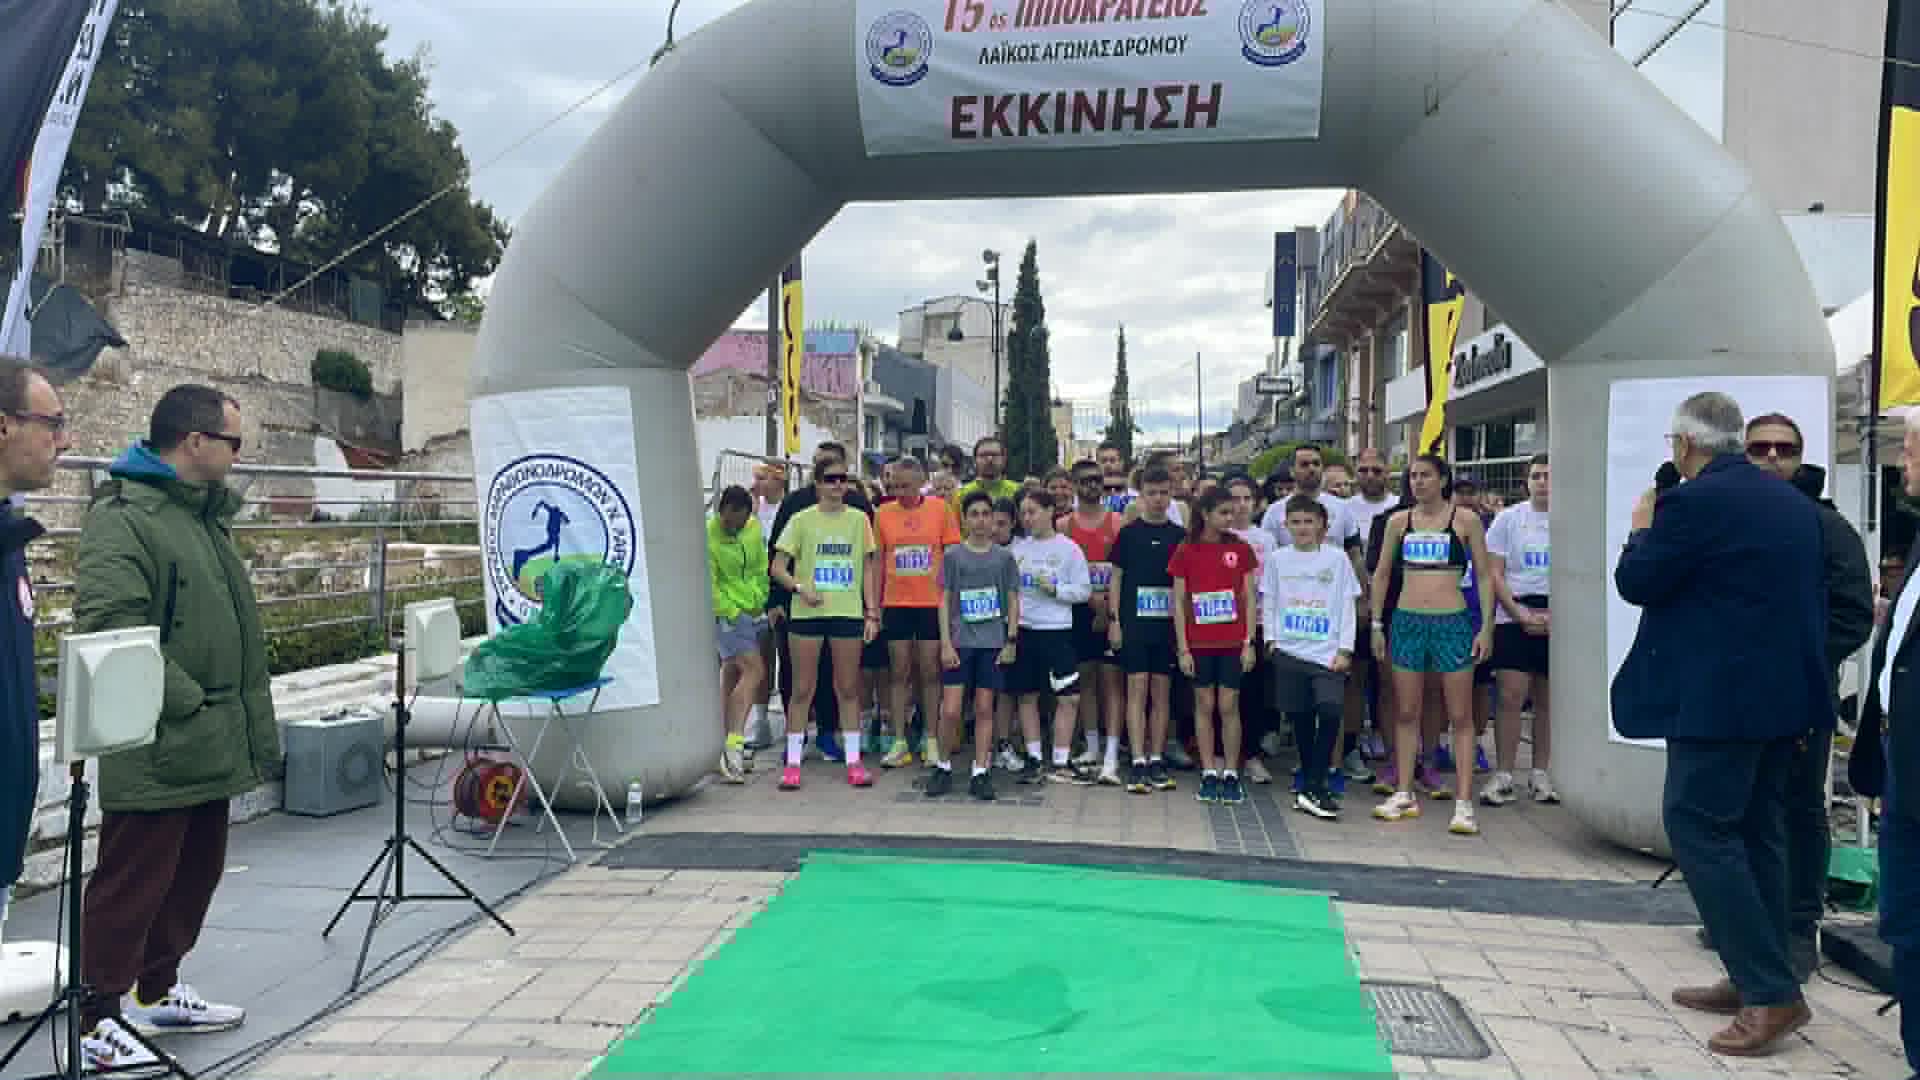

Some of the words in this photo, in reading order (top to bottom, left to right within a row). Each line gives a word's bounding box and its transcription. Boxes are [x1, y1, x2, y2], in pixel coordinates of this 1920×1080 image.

[1042, 38, 1111, 61] ΑΓΩΝΑΣ
[1111, 34, 1189, 57] ΔΡΟΜΟΥ
[951, 82, 1224, 139] ΕΚΚΙΝΗΣΗ
